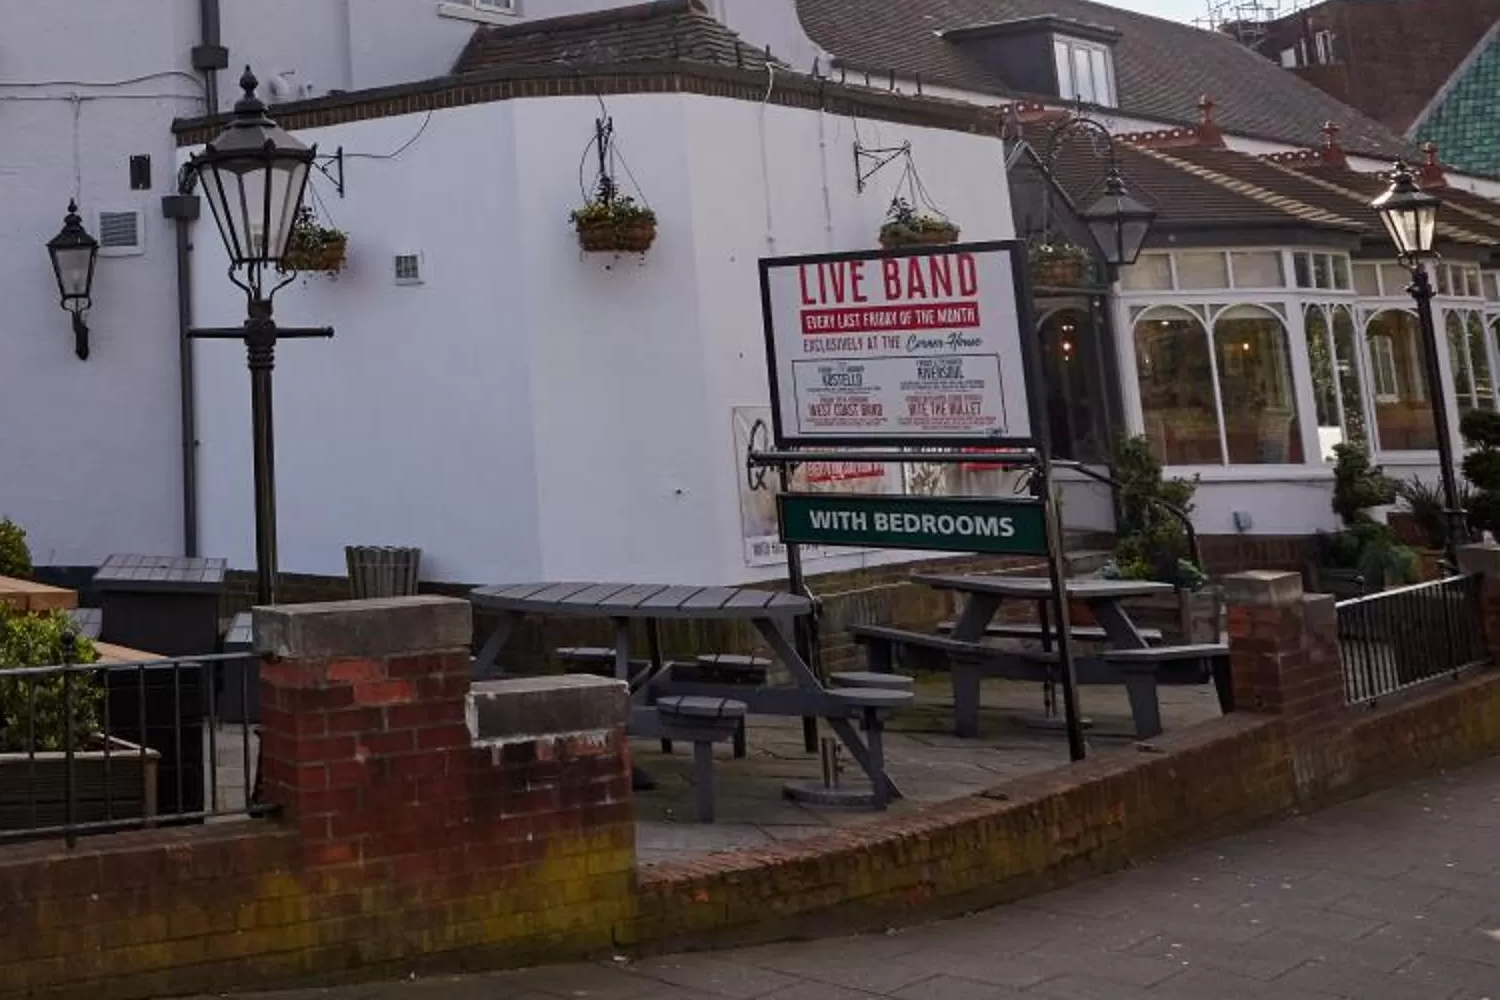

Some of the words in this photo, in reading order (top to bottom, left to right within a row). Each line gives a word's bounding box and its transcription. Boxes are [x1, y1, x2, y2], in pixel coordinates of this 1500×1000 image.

[800, 260, 867, 305] LIVE
[883, 253, 978, 301] BAND
[806, 314, 835, 330] EVERY
[837, 313, 860, 328] LAST
[863, 311, 897, 327] FRIDAY
[900, 310, 912, 325] OF
[915, 309, 934, 324] THE
[937, 307, 976, 323] MONTH
[804, 336, 863, 353] EXCLUSIVELY
[867, 336, 879, 350] AT
[882, 335, 900, 350] THE
[906, 333, 943, 352] Corner
[944, 331, 983, 351] House
[808, 404, 831, 417] WEST
[834, 403, 859, 416] COAST
[809, 510, 867, 531] WITH
[874, 513, 1015, 537] BEDROOMS
